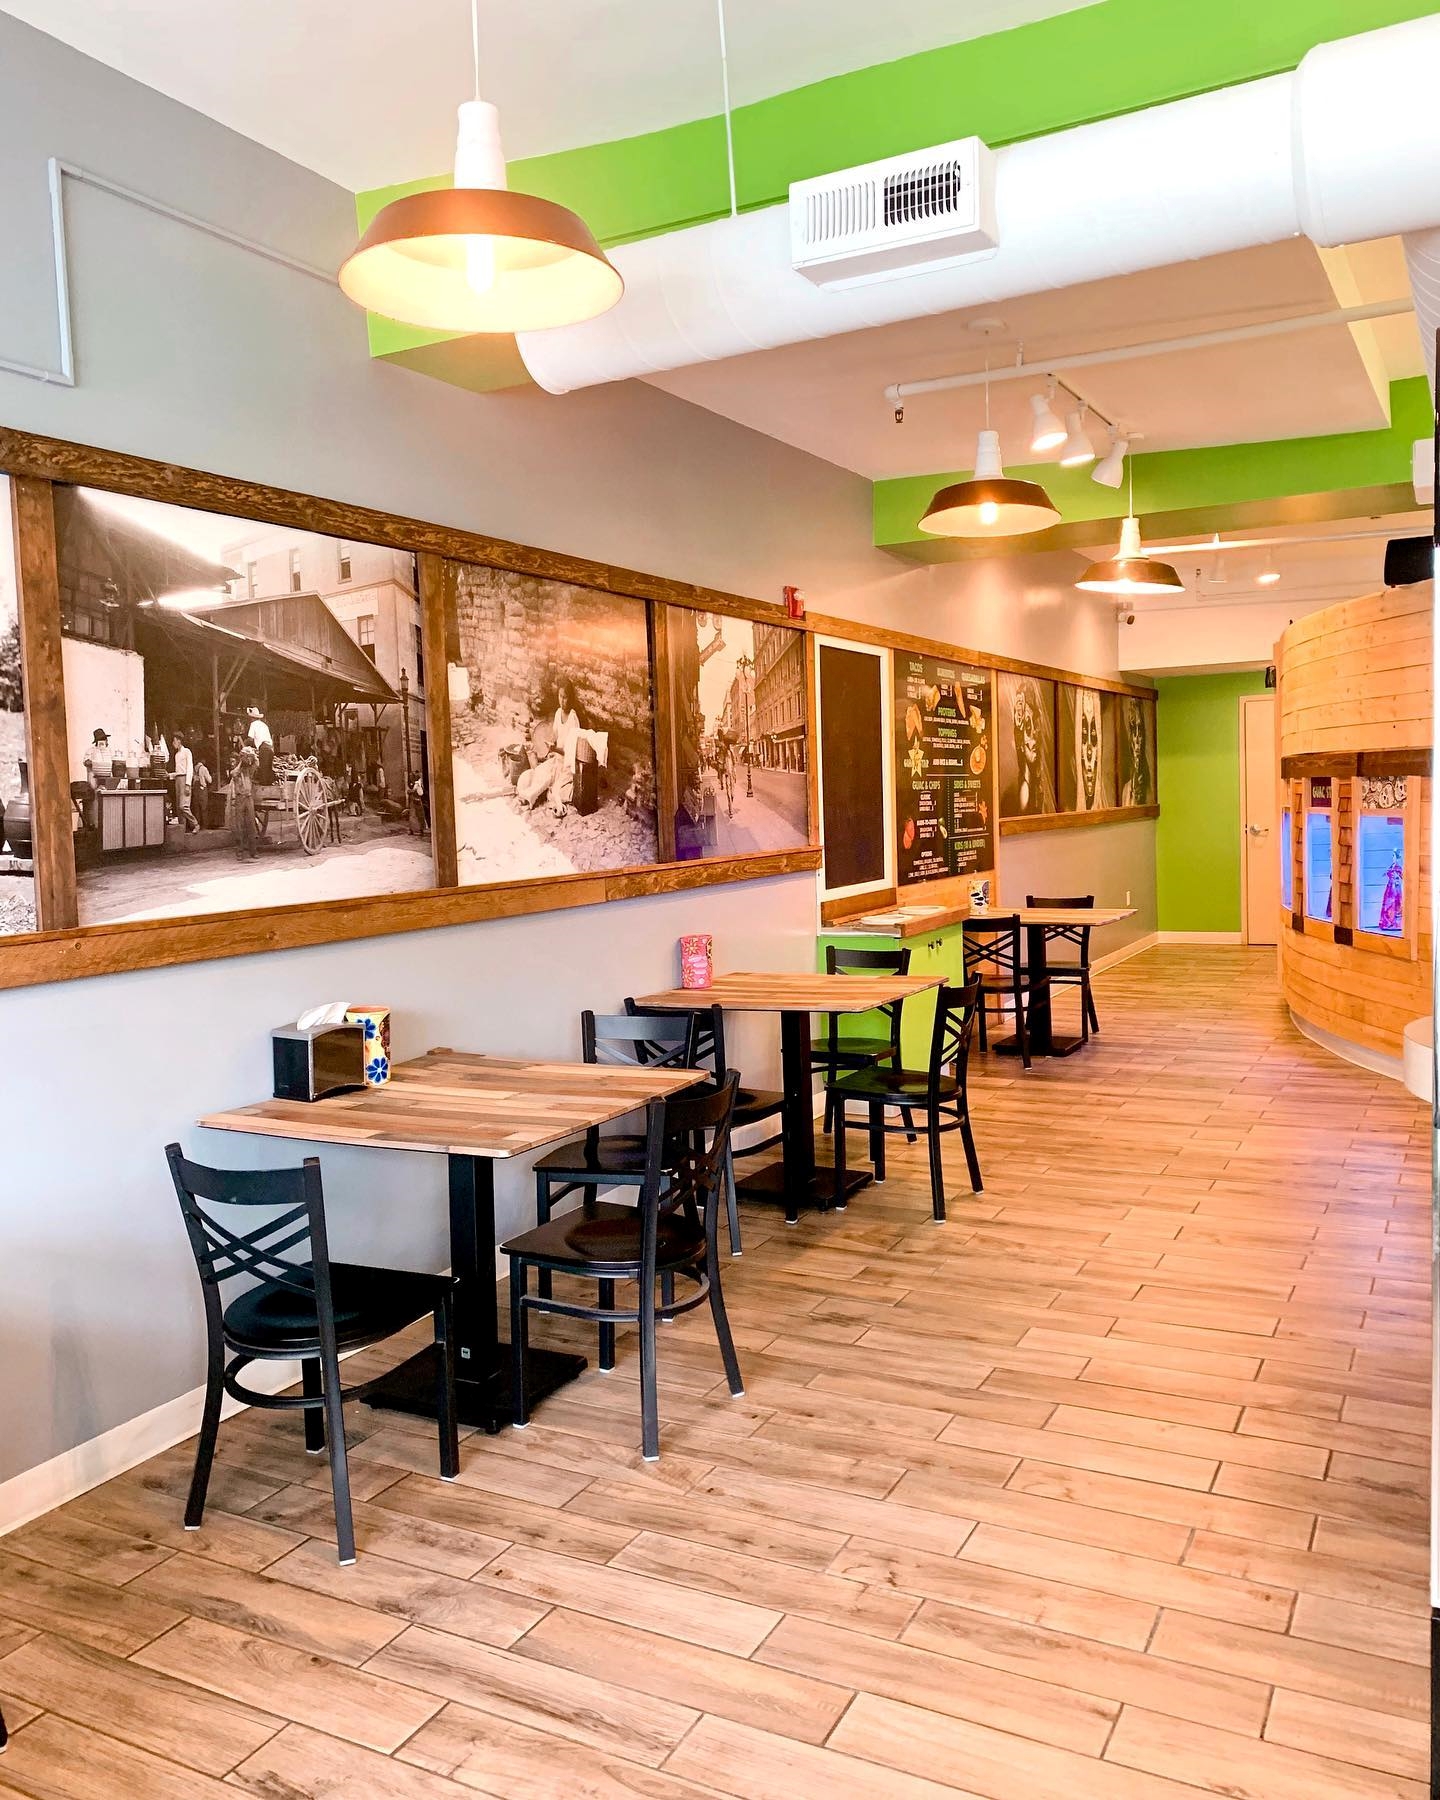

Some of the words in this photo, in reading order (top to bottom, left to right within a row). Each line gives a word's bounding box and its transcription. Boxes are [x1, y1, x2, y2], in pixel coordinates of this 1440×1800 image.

[909, 661, 923, 673] TACOS
[937, 707, 957, 718] PROTEINS
[937, 727, 958, 738] TOPPINGS
[912, 780, 925, 790] GUAC
[929, 780, 941, 790] CHIPS
[1312, 786, 1326, 799] GUAC
